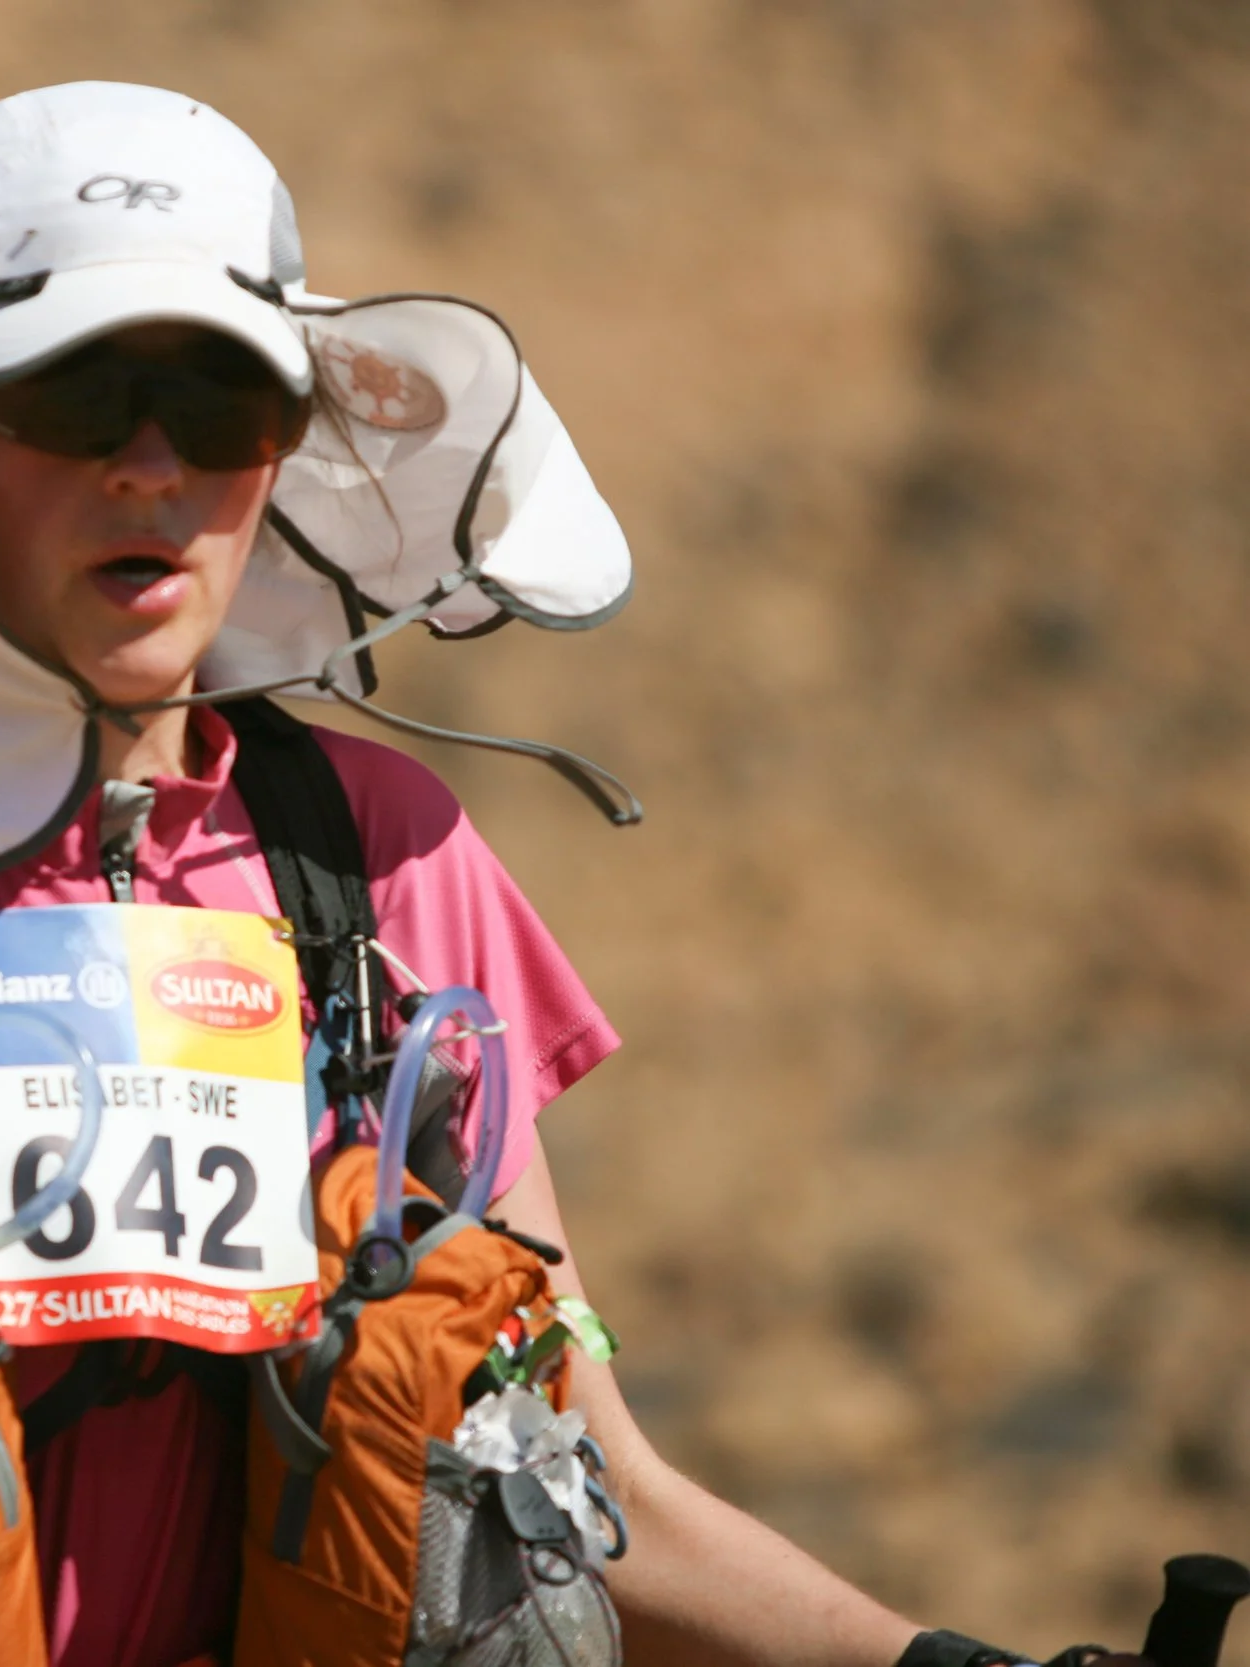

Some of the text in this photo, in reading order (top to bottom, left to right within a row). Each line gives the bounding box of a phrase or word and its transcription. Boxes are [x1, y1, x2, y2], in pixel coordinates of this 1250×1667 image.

[159, 973, 275, 1014] SULTAN
[23, 1076, 163, 1109] ELISBET
[188, 1080, 238, 1119] SWE
[12, 1134, 264, 1272] 642
[41, 1285, 172, 1328] SULTAN
